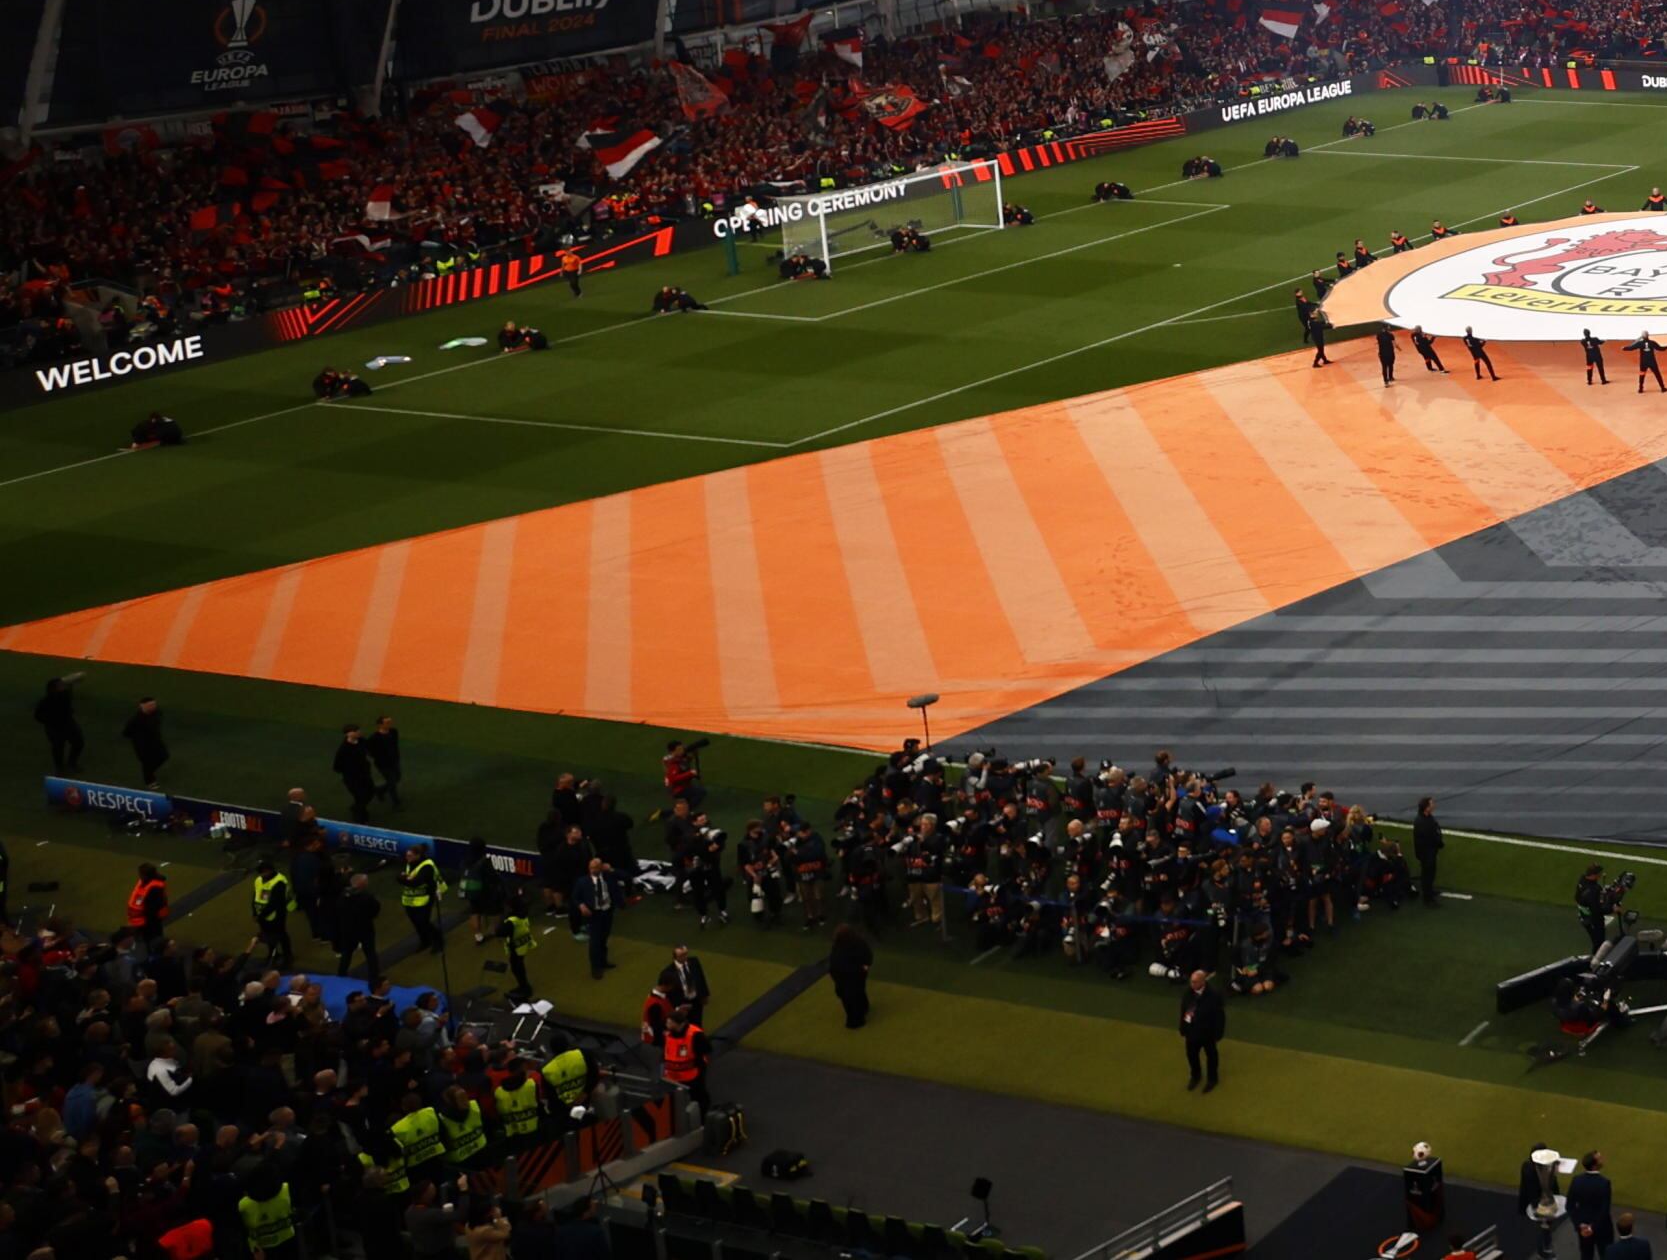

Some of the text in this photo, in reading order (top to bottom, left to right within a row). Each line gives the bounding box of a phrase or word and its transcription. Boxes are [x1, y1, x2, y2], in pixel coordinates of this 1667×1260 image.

[481, 13, 596, 40] FINAL 2024
[190, 63, 268, 84] EUROPA
[204, 80, 251, 91] LEAGUE
[1221, 100, 1256, 122] UEFA
[1258, 93, 1305, 114] EUROPA
[1306, 80, 1352, 102] LEAGUE
[36, 335, 204, 392] WELCOME
[87, 789, 153, 816] RESPECT
[353, 834, 398, 852] RESPECT
